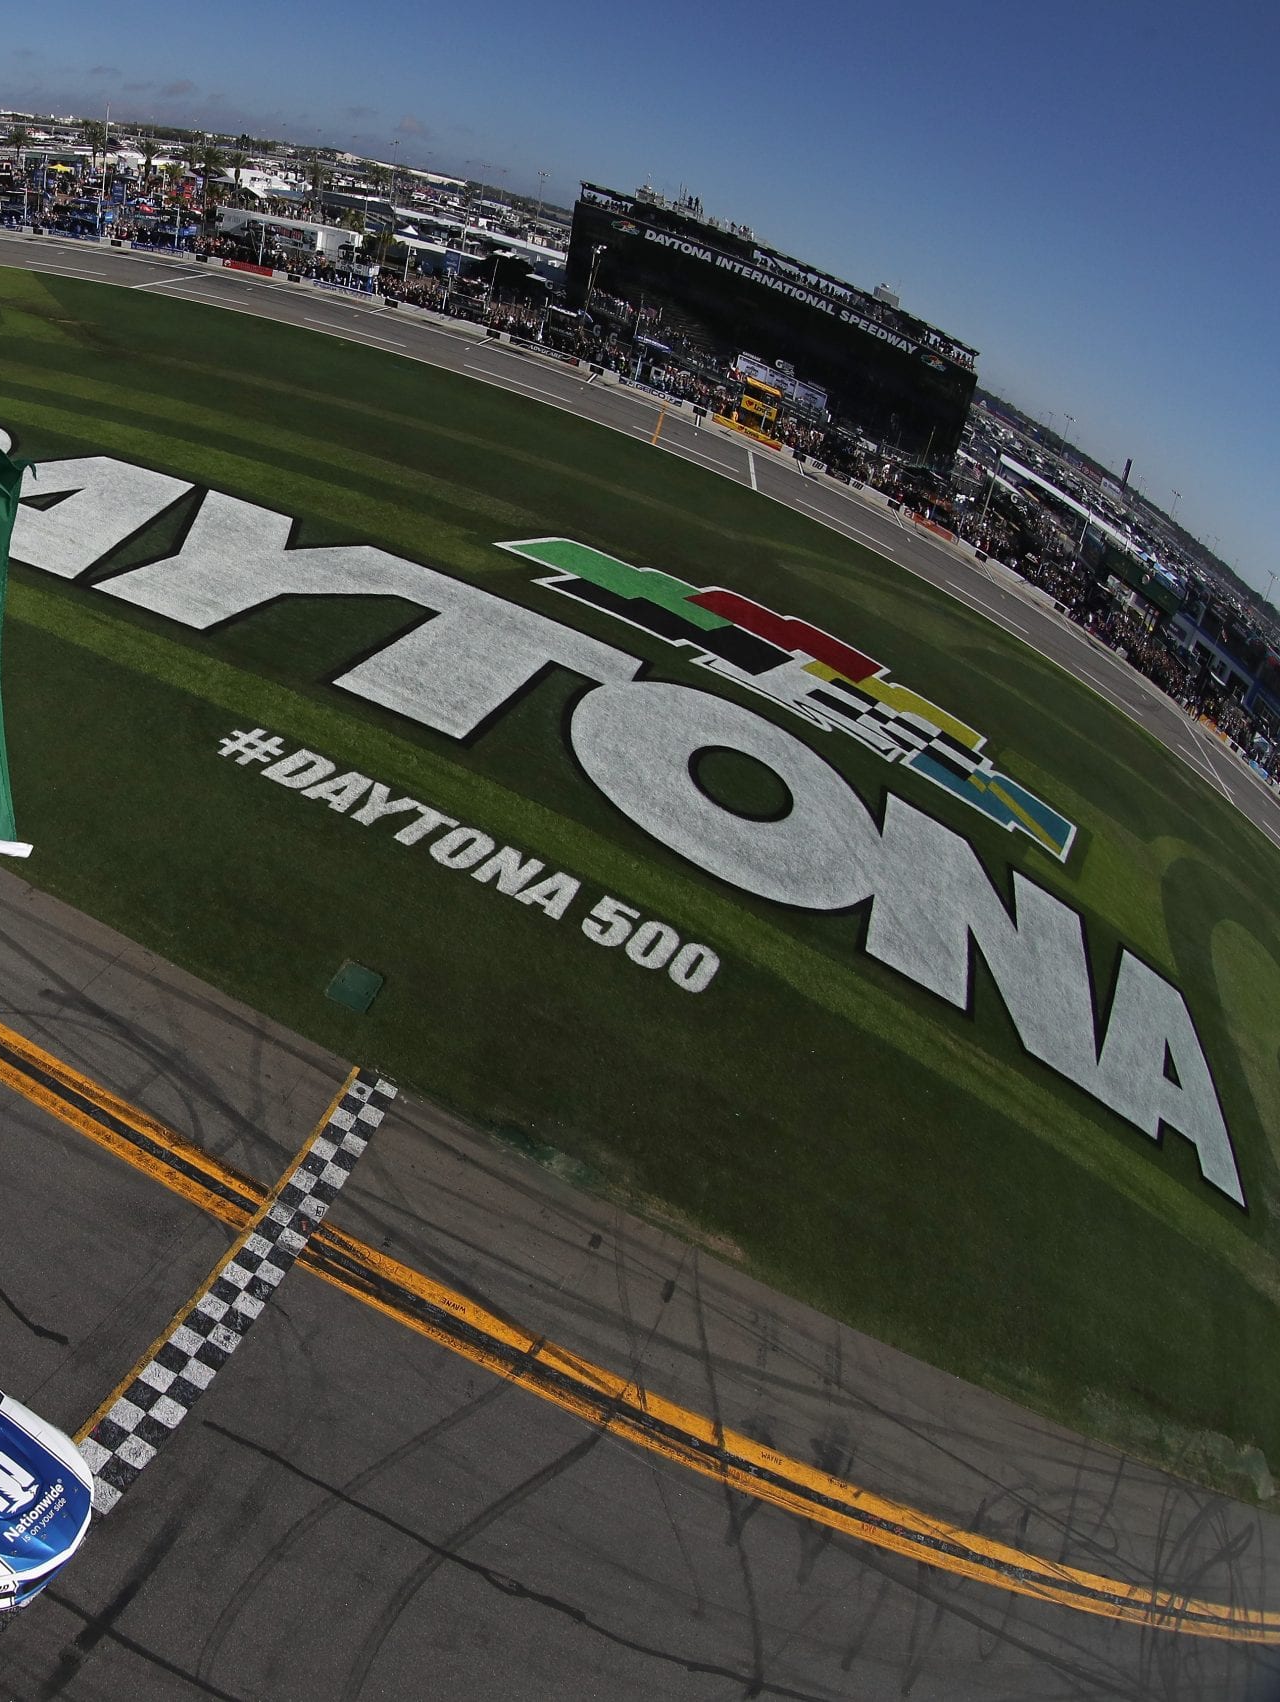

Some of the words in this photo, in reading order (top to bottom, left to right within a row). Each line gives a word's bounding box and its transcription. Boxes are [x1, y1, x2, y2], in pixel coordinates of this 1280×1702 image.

[644, 229, 712, 263] DAYTONA
[715, 255, 836, 317] INTERNATIONAL
[840, 309, 918, 355] SPEEDWAY
[634, 382, 666, 400] GEICO
[217, 728, 581, 920] #DAYTONA
[581, 895, 721, 993] 500
[4, 1480, 65, 1543] Nationwide
[21, 1531, 32, 1544] is
[29, 1523, 42, 1537] on
[39, 1508, 59, 1530] your
[52, 1497, 68, 1514] side
